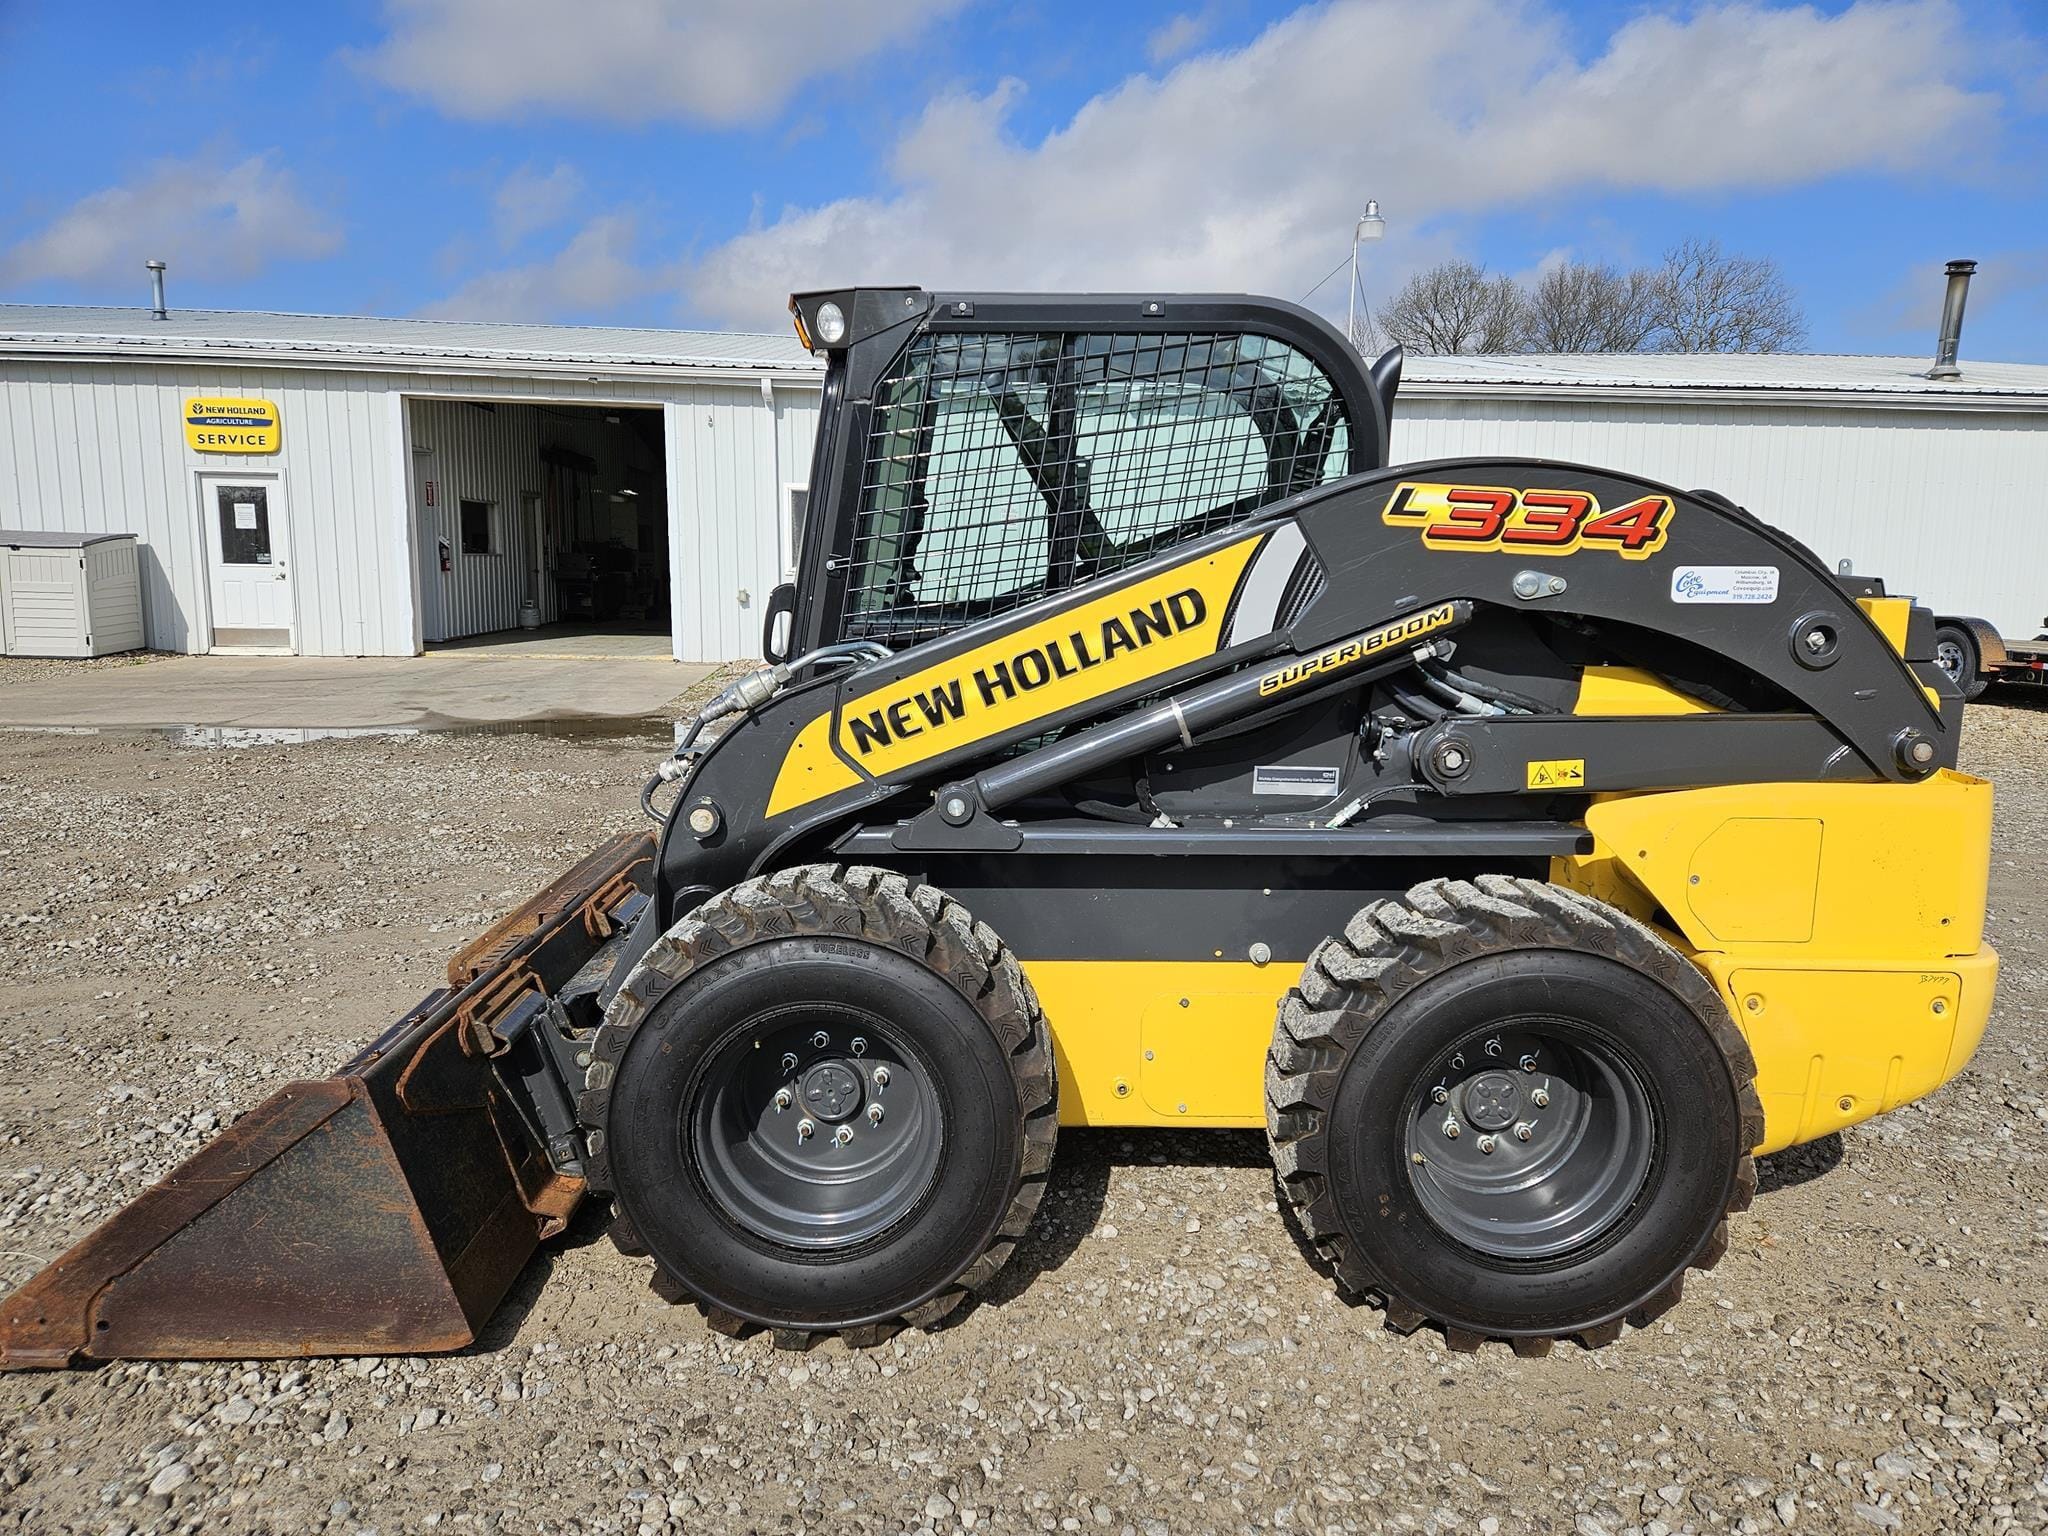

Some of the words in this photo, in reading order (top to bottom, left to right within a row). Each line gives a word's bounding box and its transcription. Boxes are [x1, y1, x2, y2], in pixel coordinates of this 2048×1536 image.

[205, 406, 225, 414] NEW
[227, 407, 266, 415] HOLLAND
[206, 418, 254, 426] AGRICULTURE
[197, 434, 266, 446] SERVICE
[1675, 570, 1704, 592] Cove
[1686, 586, 1730, 599] Equipment
[848, 678, 966, 756] NEW
[972, 587, 1208, 708] HOLLAND
[813, 943, 870, 961] TUBELESS
